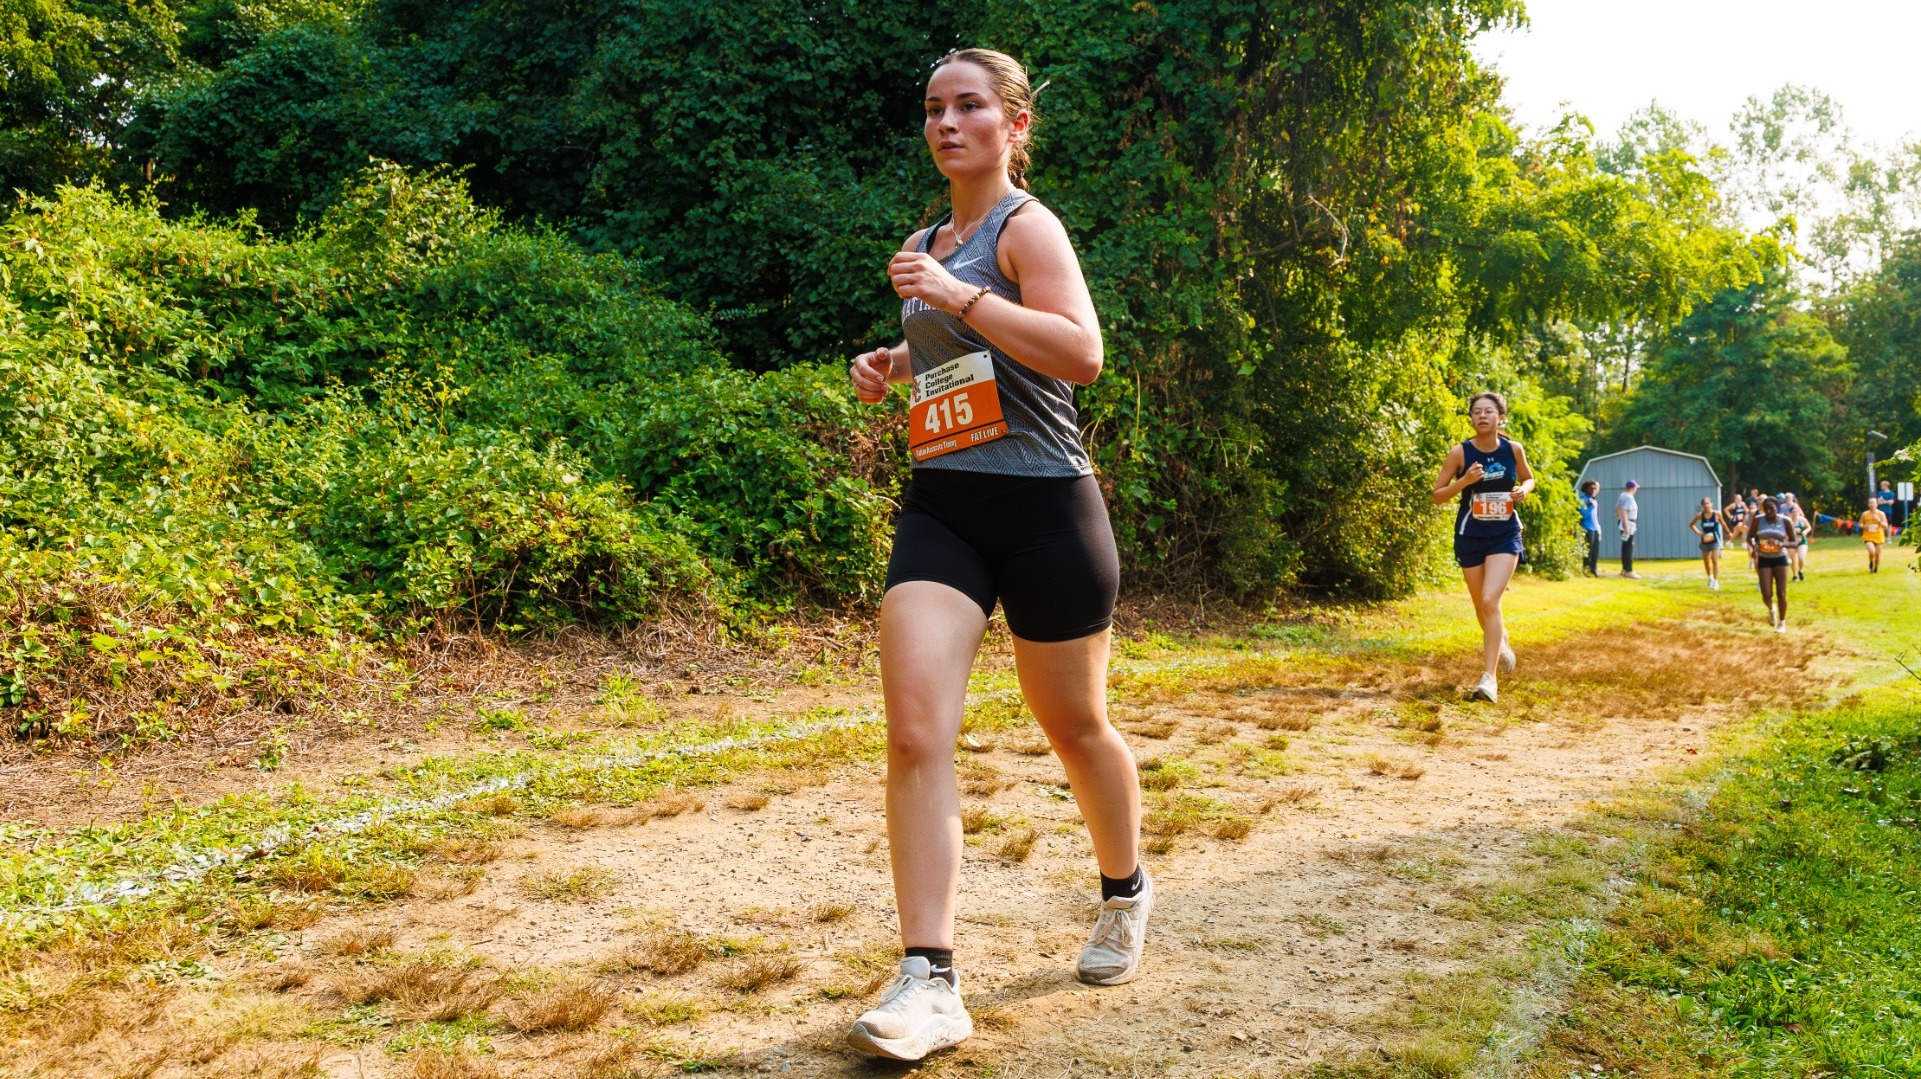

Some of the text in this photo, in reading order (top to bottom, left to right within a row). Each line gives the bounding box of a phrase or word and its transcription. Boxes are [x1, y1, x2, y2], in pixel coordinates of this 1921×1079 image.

[925, 362, 960, 382] Purchase
[925, 373, 953, 389] College
[925, 374, 975, 398] Invitational
[925, 392, 973, 434] 415
[971, 426, 999, 443] FAT LIVE
[1480, 501, 1507, 515] 196
